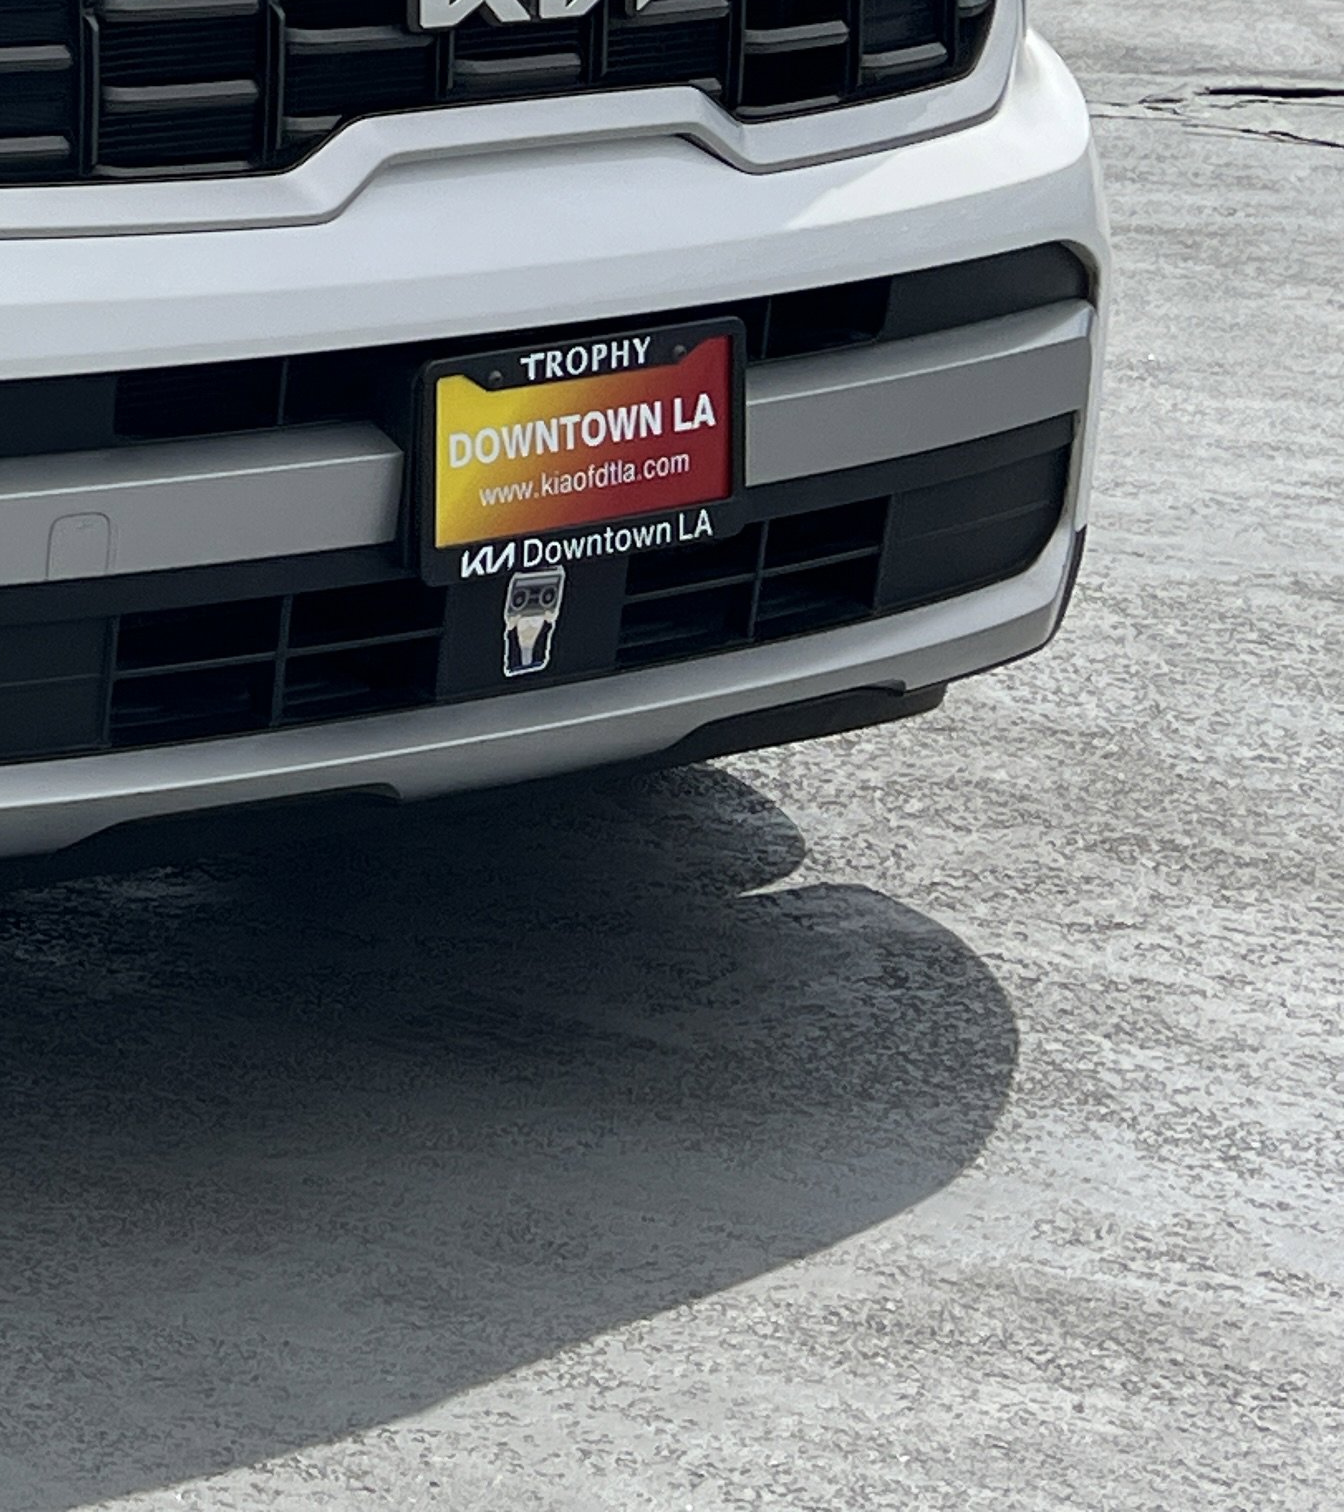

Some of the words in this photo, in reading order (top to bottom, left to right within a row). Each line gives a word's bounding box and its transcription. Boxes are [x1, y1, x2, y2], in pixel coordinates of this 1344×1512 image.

[520, 336, 652, 381] TROPHY
[448, 400, 663, 468] DOWNTOWN
[673, 393, 716, 432] LA
[478, 453, 690, 507] www.kiaofdtla.com
[460, 542, 516, 578] KIA
[523, 518, 672, 568] Downtown
[678, 508, 714, 541] LA
